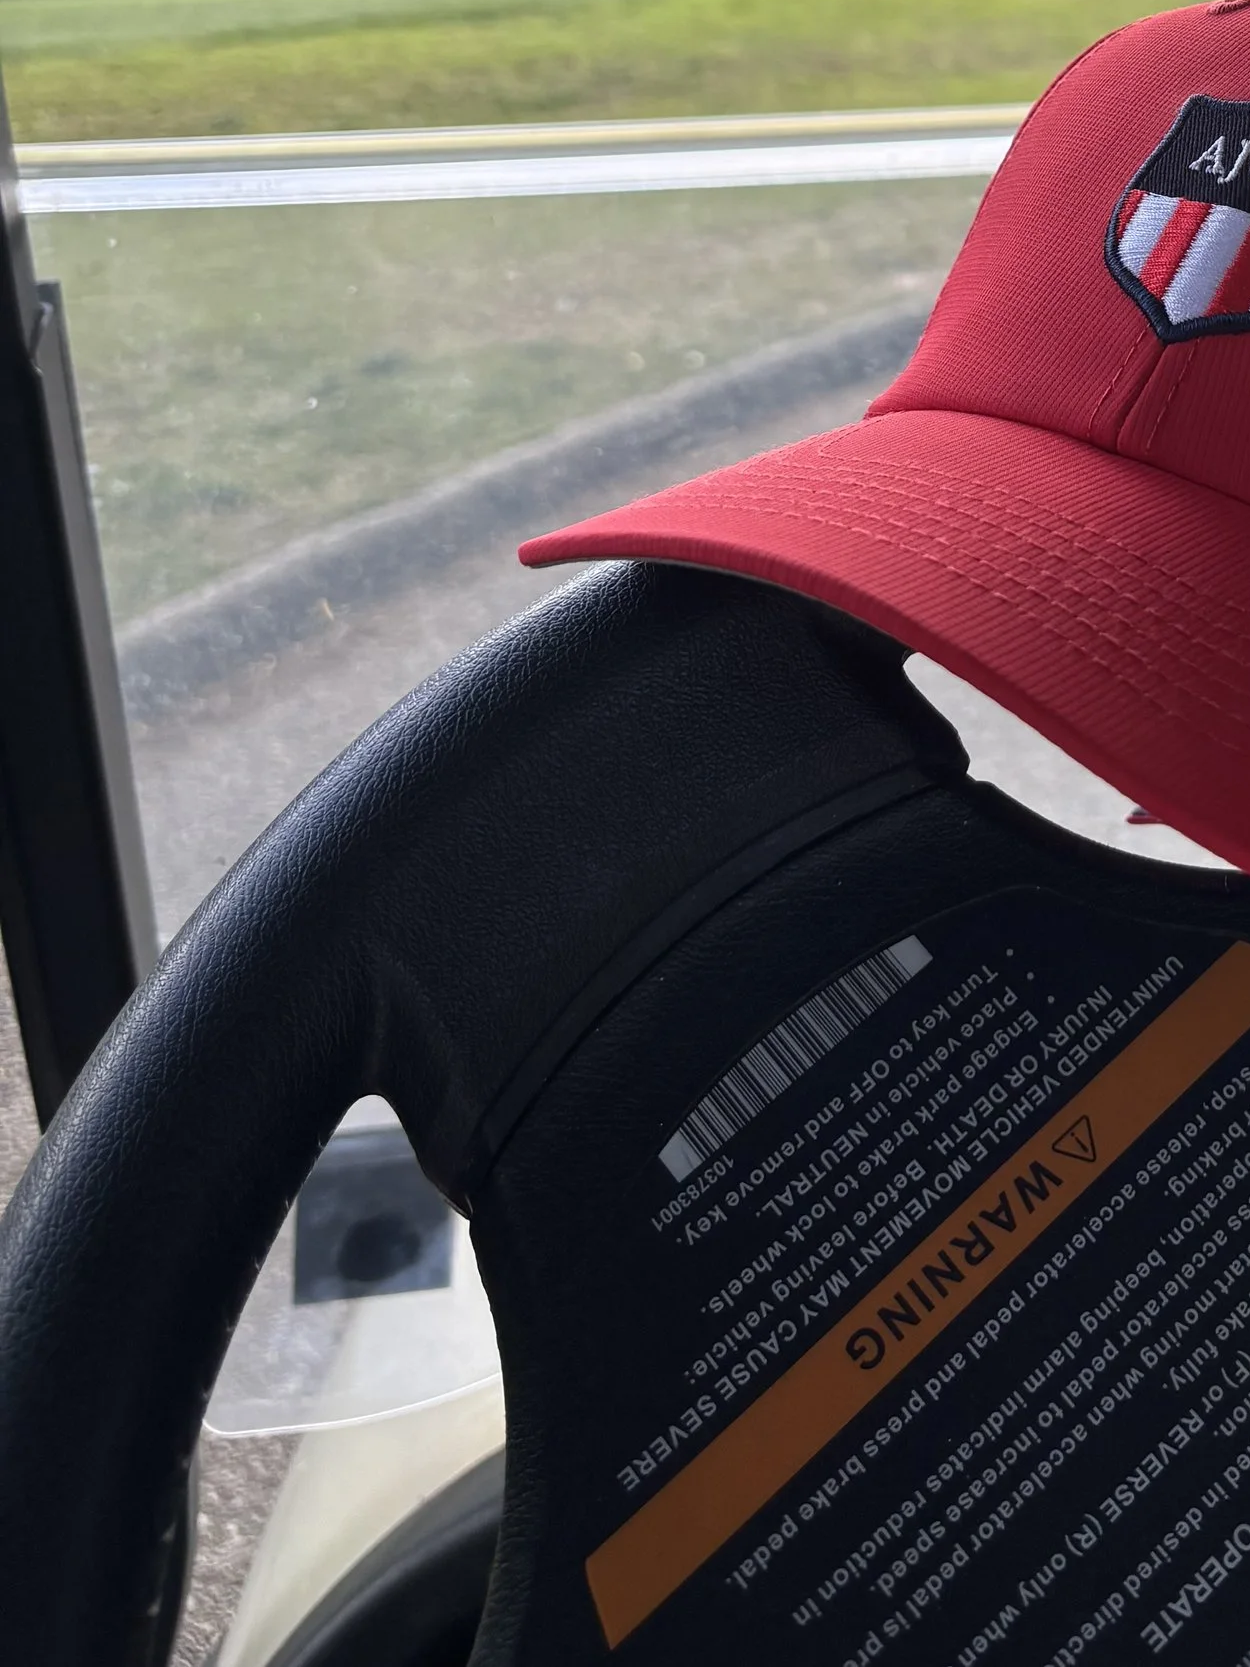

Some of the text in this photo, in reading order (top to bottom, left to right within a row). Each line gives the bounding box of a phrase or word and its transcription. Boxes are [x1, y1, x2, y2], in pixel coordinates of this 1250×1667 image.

[675, 964, 999, 1246] Turn key to OFF and remove key.
[755, 985, 1019, 1218] Place vehicle in NEUTRAL.
[683, 984, 1113, 1385] INJURY OR DEATH. Before leaving vehicle:
[700, 1009, 1039, 1314] Engage park brake to lock wheels.
[1135, 1113, 1207, 1186] release
[1163, 1121, 1248, 1198] braking.
[616, 955, 1185, 1492] UNINTENDED VEHICLE MOVEMENT MAY CAUSE SEVERE
[650, 1154, 734, 1233] 103783001
[846, 1161, 1064, 1371] WARNING
[1025, 1183, 1137, 1299] accelerator
[965, 1289, 1026, 1360] pedal
[1079, 1248, 1167, 1335] beeping
[1119, 1229, 1228, 1347] accelerator
[1022, 1330, 1083, 1394] alarm
[1139, 1288, 1218, 1370] moving
[1161, 1338, 1219, 1392] fully.
[924, 1352, 967, 1401] and
[1060, 1338, 1120, 1409] pedal
[1086, 1367, 1145, 1427] when
[1201, 1384, 1224, 1414] or
[862, 1389, 926, 1458] press
[925, 1390, 1028, 1493] indicates
[1037, 1401, 1064, 1428] to
[798, 1454, 867, 1521] brake
[945, 1425, 1042, 1523] increase
[970, 1423, 1088, 1552] accelerator
[1098, 1408, 1205, 1524] REVERSE
[1200, 1481, 1230, 1509] in
[725, 1513, 799, 1590] pedal.
[817, 1489, 927, 1601] reduction
[869, 1520, 946, 1597] speed.
[1064, 1513, 1104, 1557] (R)
[1122, 1507, 1203, 1599] desired
[791, 1597, 823, 1626] in
[905, 1542, 970, 1619] pedal
[1018, 1552, 1067, 1607] only
[882, 1610, 911, 1638] is
[957, 1604, 1021, 1667] when
